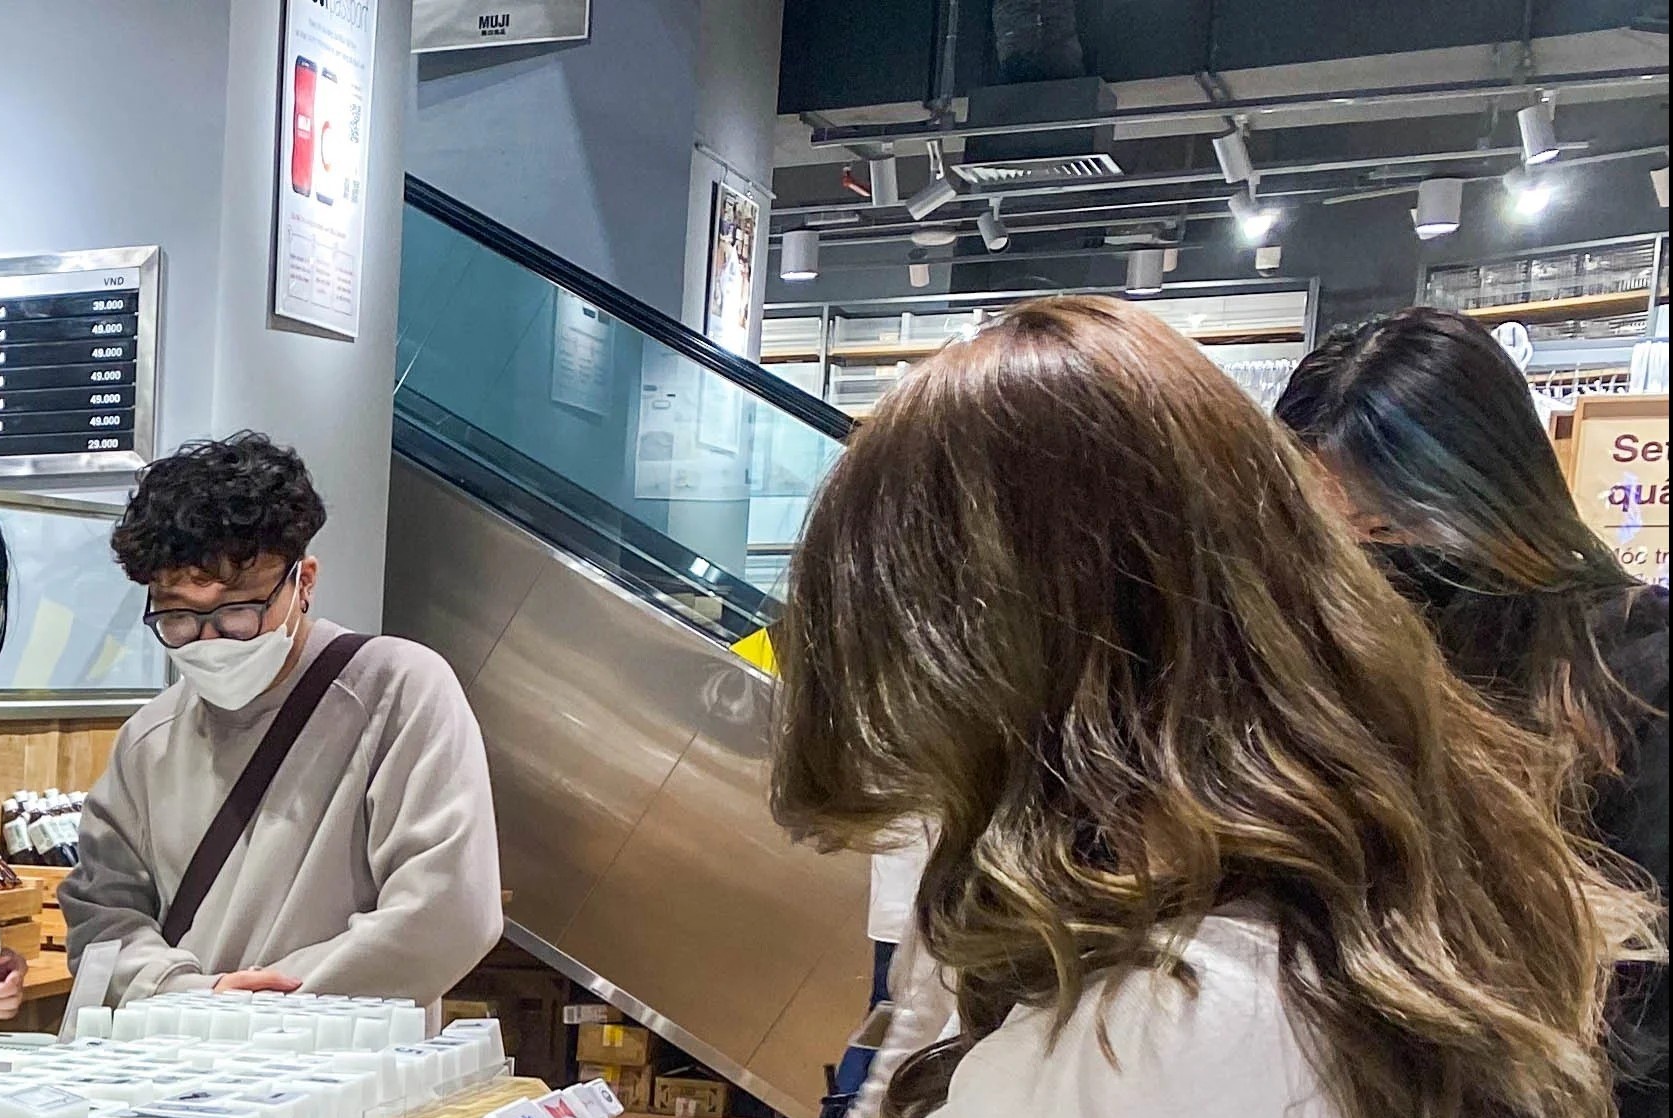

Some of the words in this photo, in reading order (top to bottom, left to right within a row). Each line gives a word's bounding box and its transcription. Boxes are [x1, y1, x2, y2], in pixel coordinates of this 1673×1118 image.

[479, 14, 510, 29] MUJI
[104, 276, 124, 286] VND
[1612, 434, 1669, 463] Se
